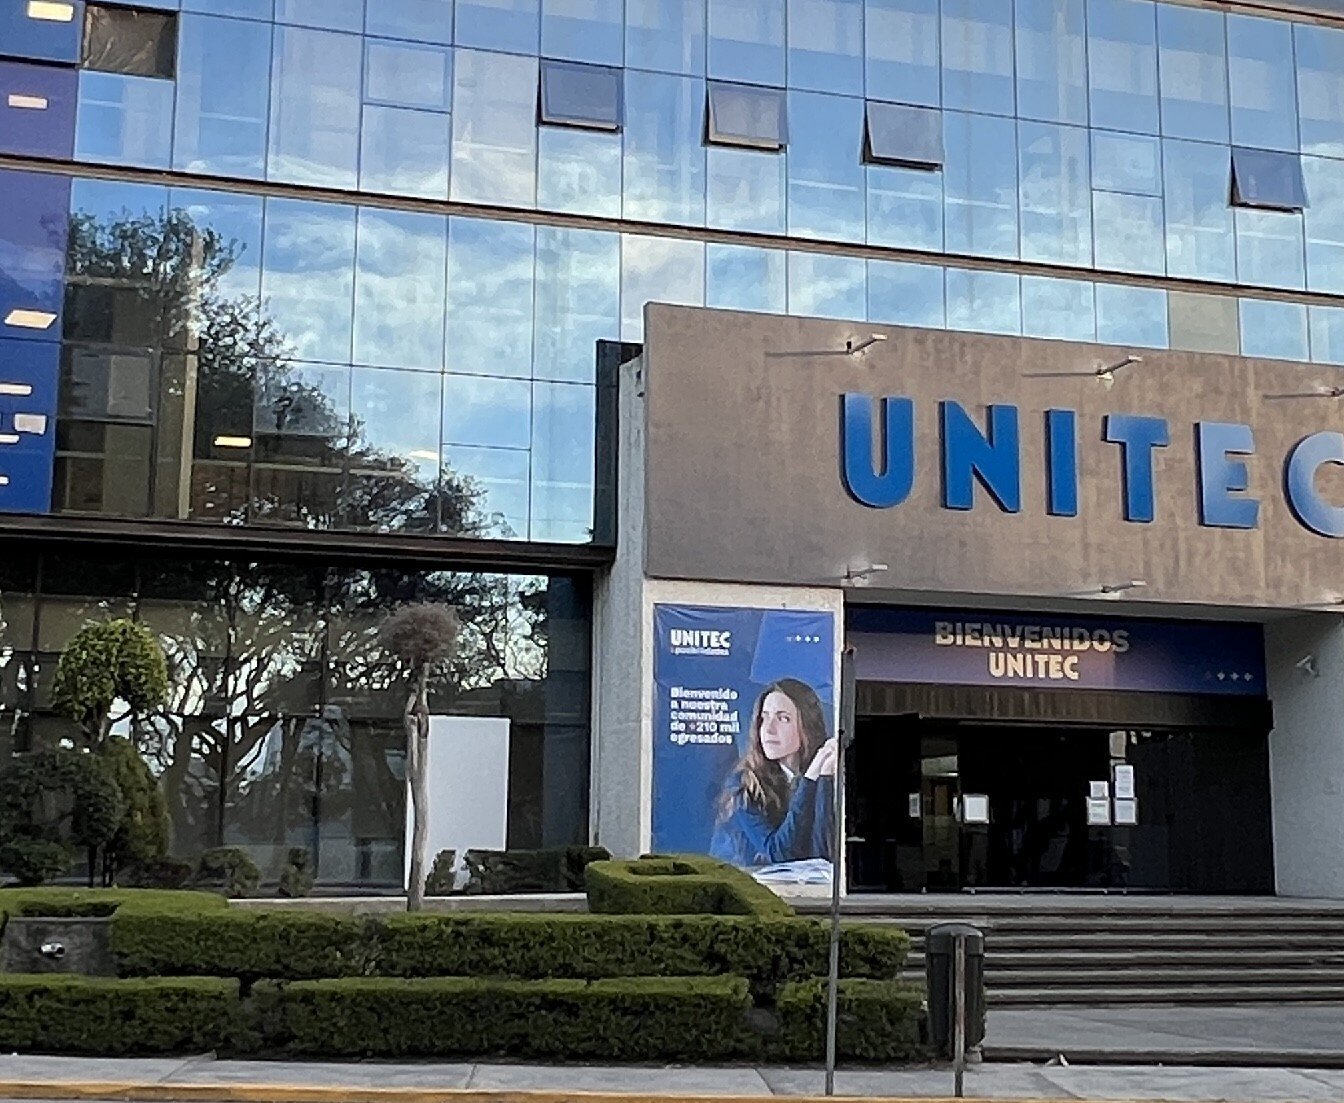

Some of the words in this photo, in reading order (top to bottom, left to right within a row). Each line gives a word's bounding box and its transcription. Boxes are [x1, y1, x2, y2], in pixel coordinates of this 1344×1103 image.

[670, 628, 731, 648] UNITEC
[935, 621, 1130, 652] BIENVENIDOS
[989, 652, 1079, 680] UNITEC
[670, 686, 738, 700] Bienvenido
[670, 700, 679, 709] a
[681, 699, 728, 711] nuestra
[670, 710, 738, 722] comunidad
[670, 721, 686, 731] de
[719, 722, 740, 733] mil
[670, 733, 733, 745] egresados
